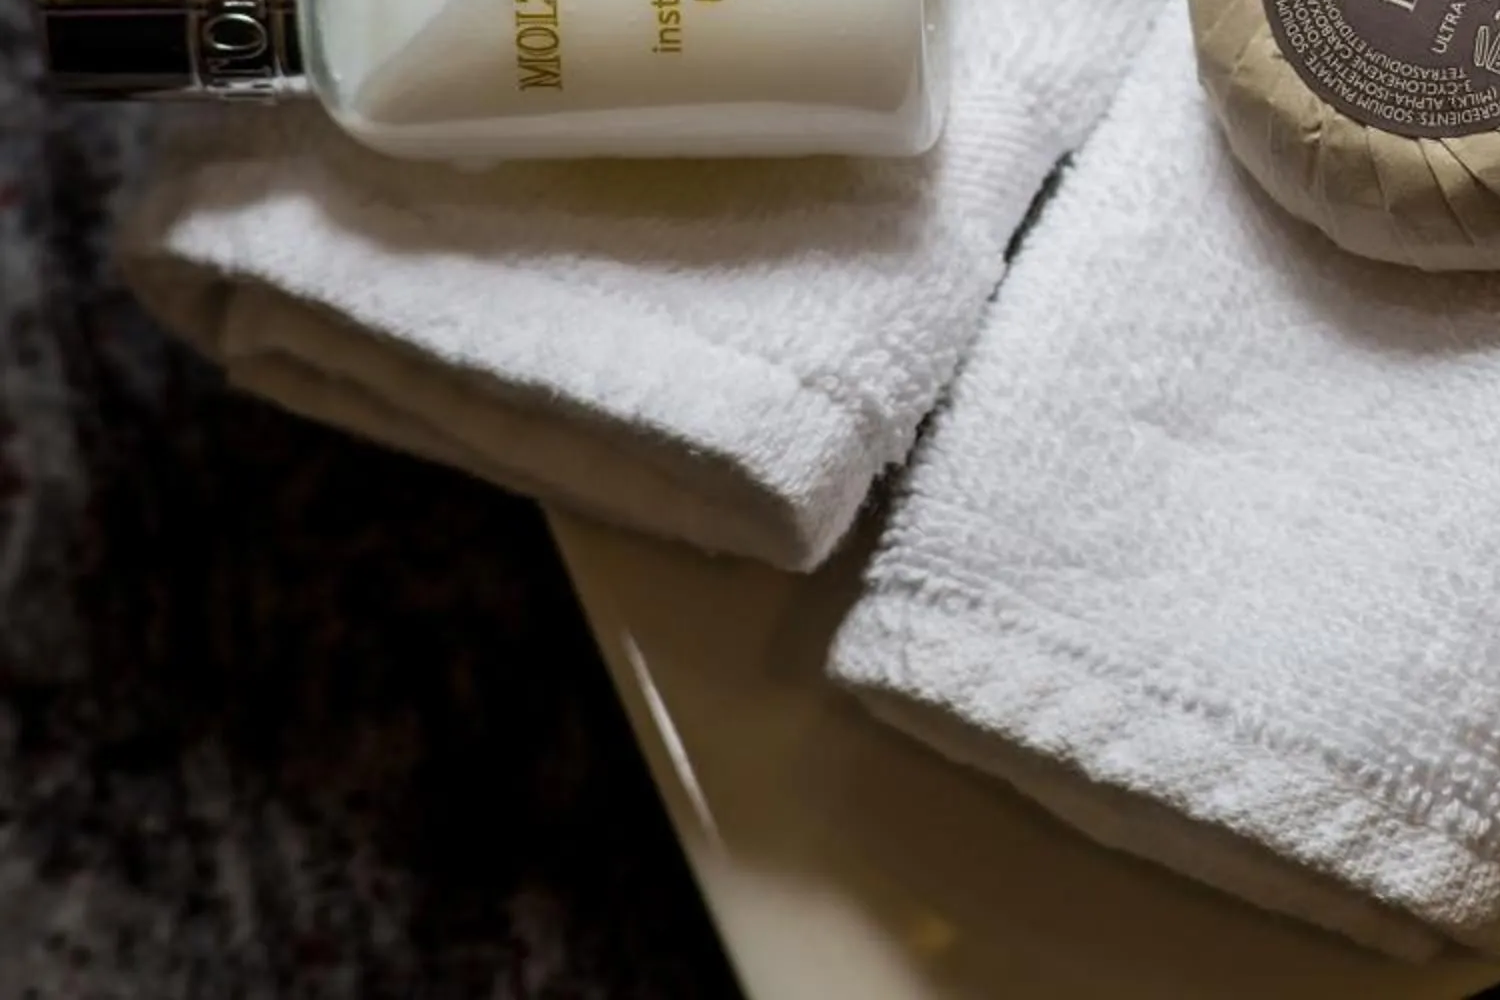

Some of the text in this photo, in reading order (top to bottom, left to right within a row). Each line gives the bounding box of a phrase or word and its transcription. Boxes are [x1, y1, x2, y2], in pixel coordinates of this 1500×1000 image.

[1432, 2, 1466, 53] ULTRA
[1316, 42, 1442, 111] ALPHA-ISOMETHYL
[1362, 45, 1467, 81] TETRASODIUM
[1355, 94, 1415, 124] SODIUM
